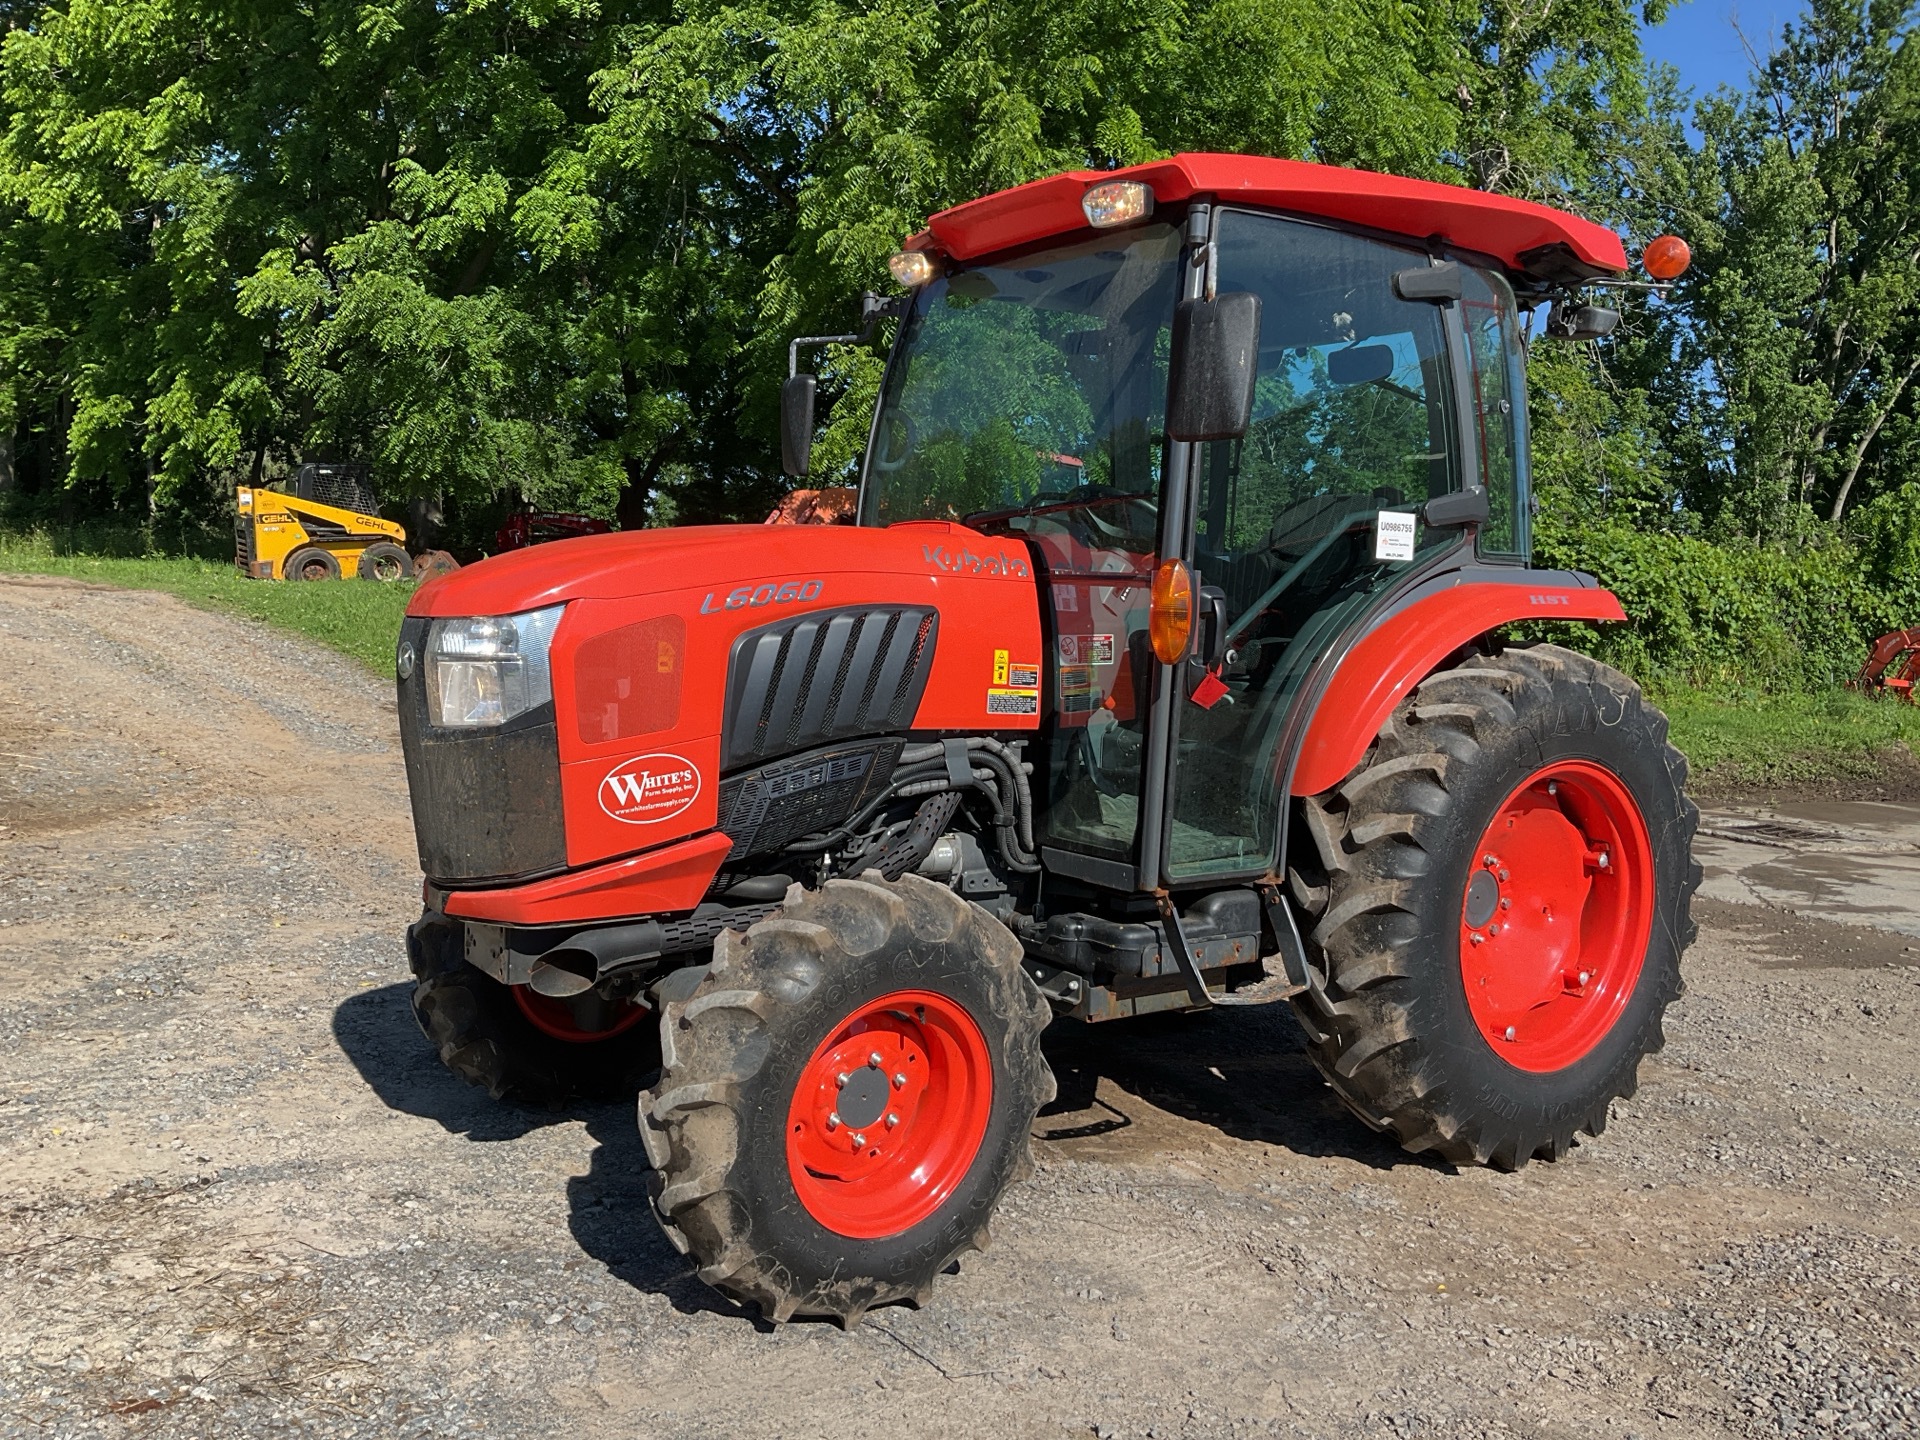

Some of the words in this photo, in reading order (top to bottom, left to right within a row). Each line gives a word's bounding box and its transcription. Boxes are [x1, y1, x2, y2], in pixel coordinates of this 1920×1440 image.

[262, 514, 292, 524] GEHL
[356, 516, 388, 531] GEHL
[923, 545, 1029, 577] Kubota
[700, 580, 823, 615] L6060
[1529, 594, 1570, 605] HST
[645, 789, 661, 797] Farm
[662, 785, 683, 794] Supply,
